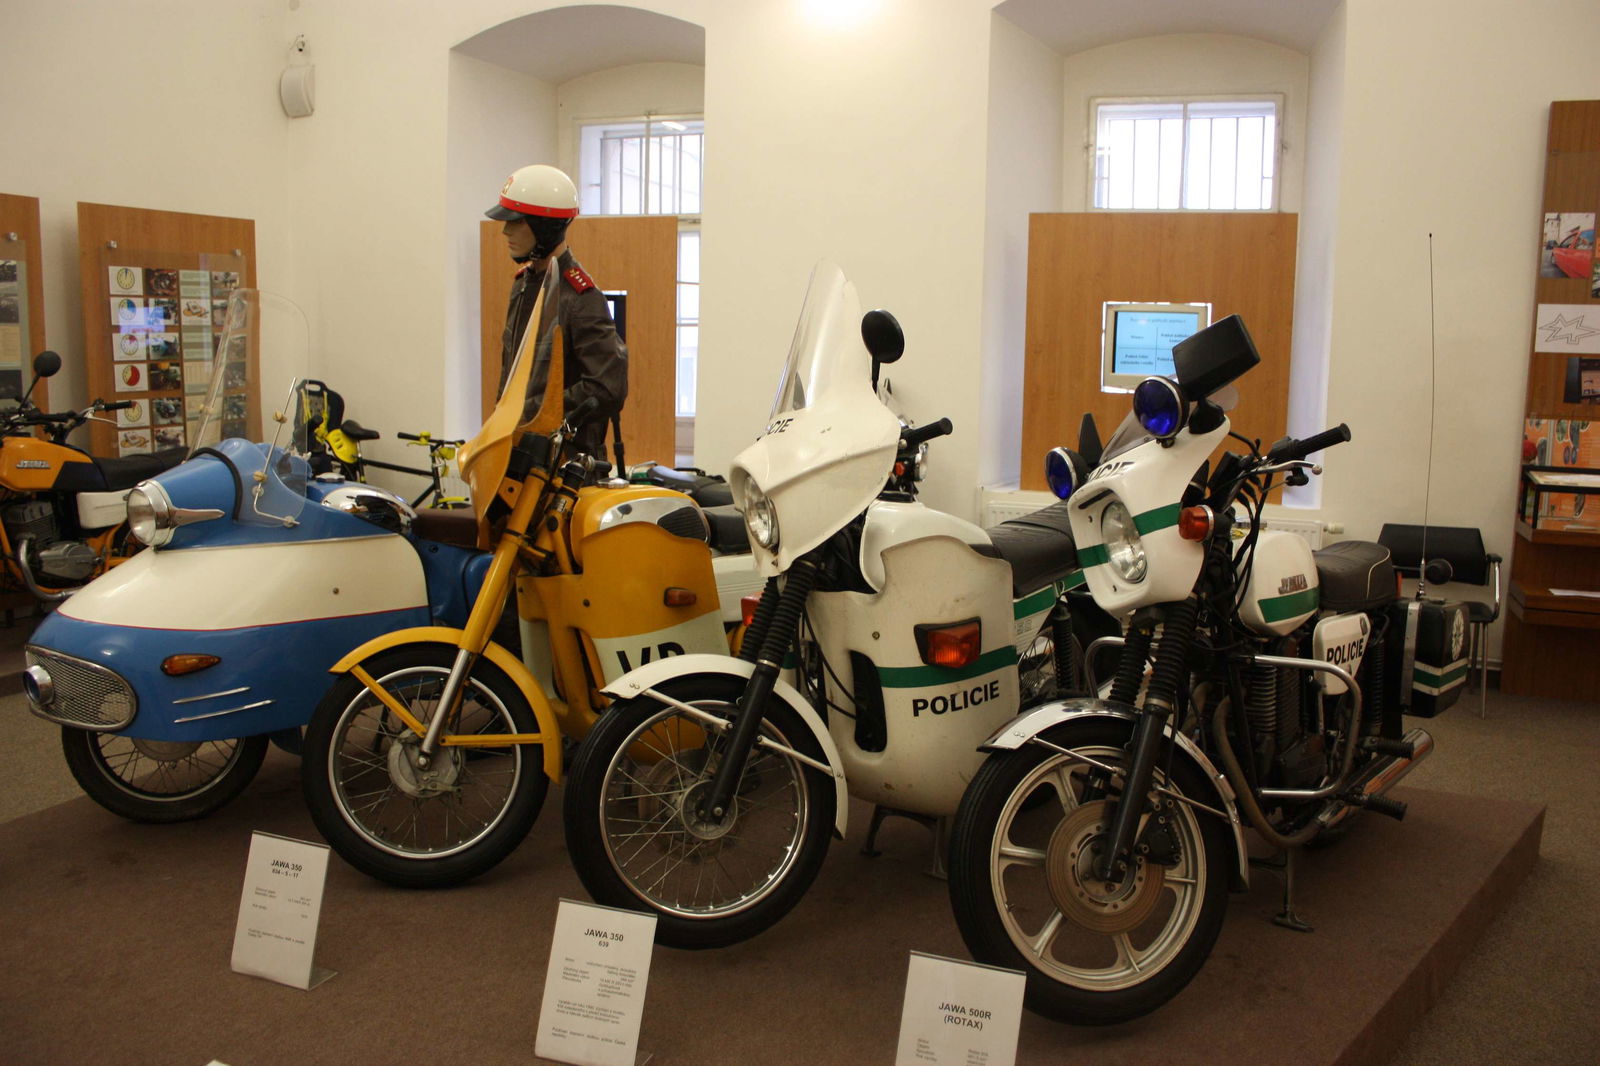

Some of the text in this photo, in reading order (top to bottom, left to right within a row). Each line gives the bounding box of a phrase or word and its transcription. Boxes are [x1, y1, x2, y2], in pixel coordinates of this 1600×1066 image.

[1326, 638, 1364, 665] POLICIE
[912, 680, 1000, 717] POLICIE
[271, 860, 303, 872] JAWA 350
[584, 928, 624, 942] JAWA 350
[938, 1002, 992, 1020] JAWA 500R
[944, 1014, 983, 1031] (ROTAX)
